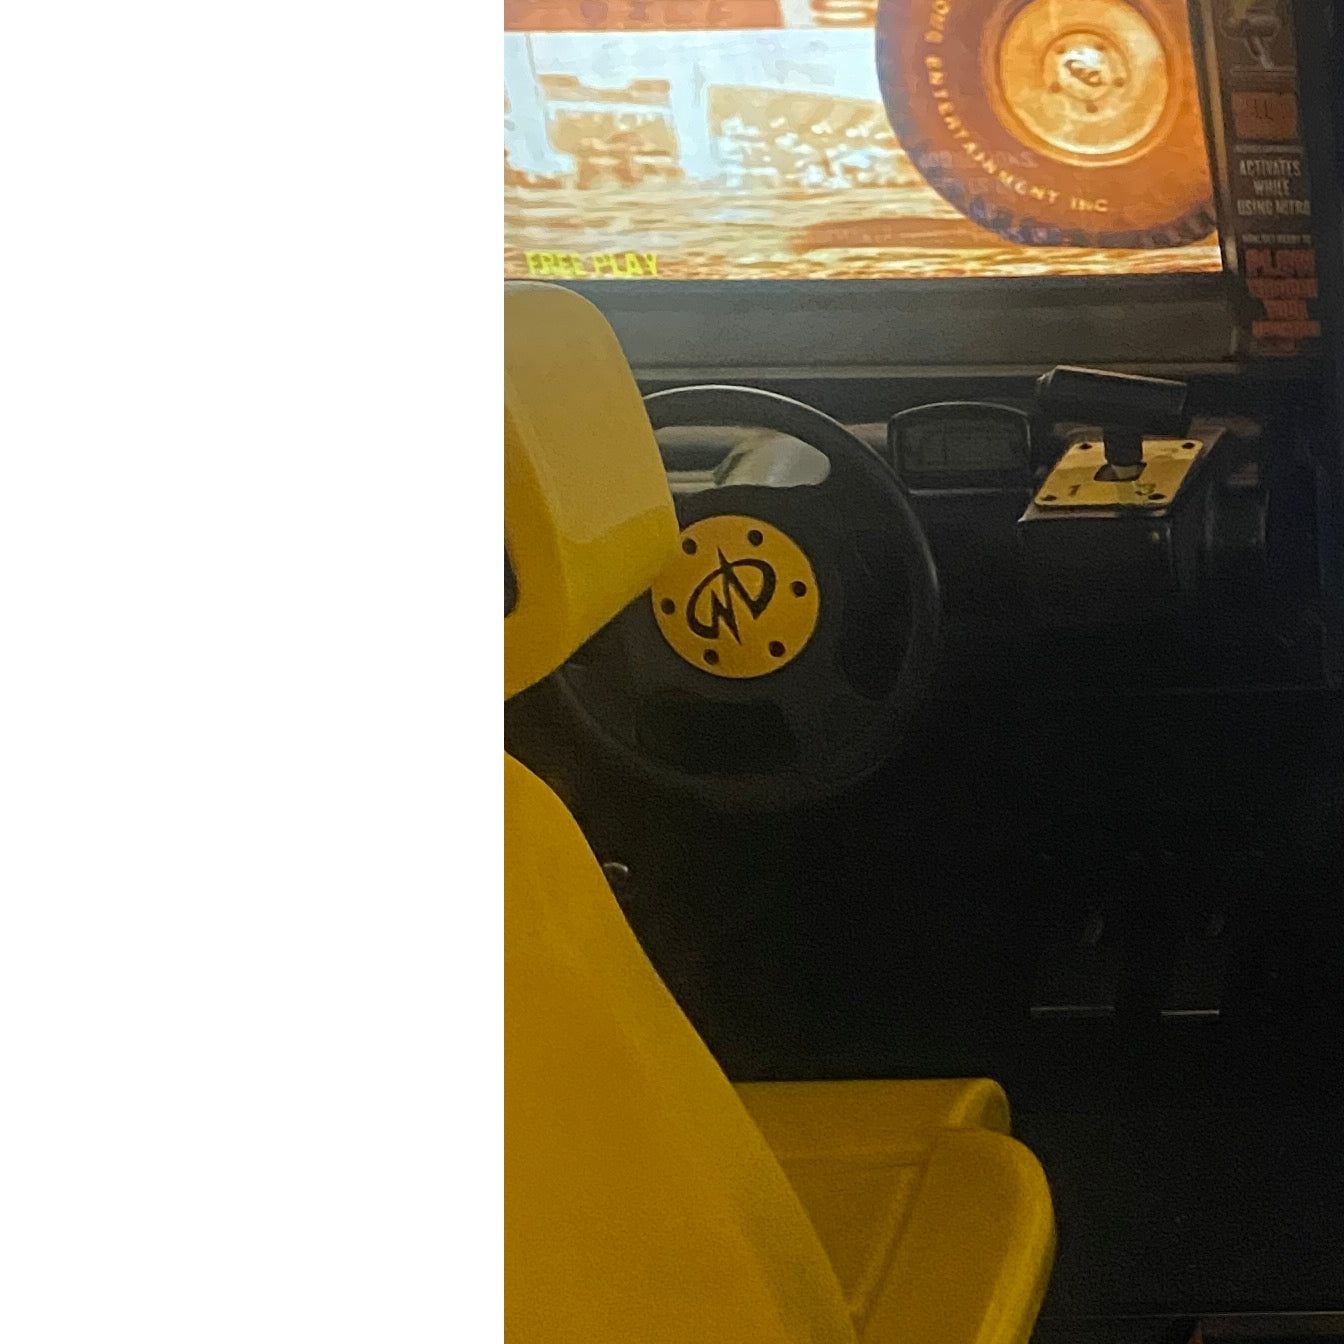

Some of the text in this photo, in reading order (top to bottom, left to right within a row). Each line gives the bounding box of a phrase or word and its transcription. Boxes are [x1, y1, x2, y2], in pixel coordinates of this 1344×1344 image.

[1238, 159, 1301, 177] ACTIVATES
[1253, 179, 1290, 196] WHILE
[592, 250, 657, 277] PLAY
